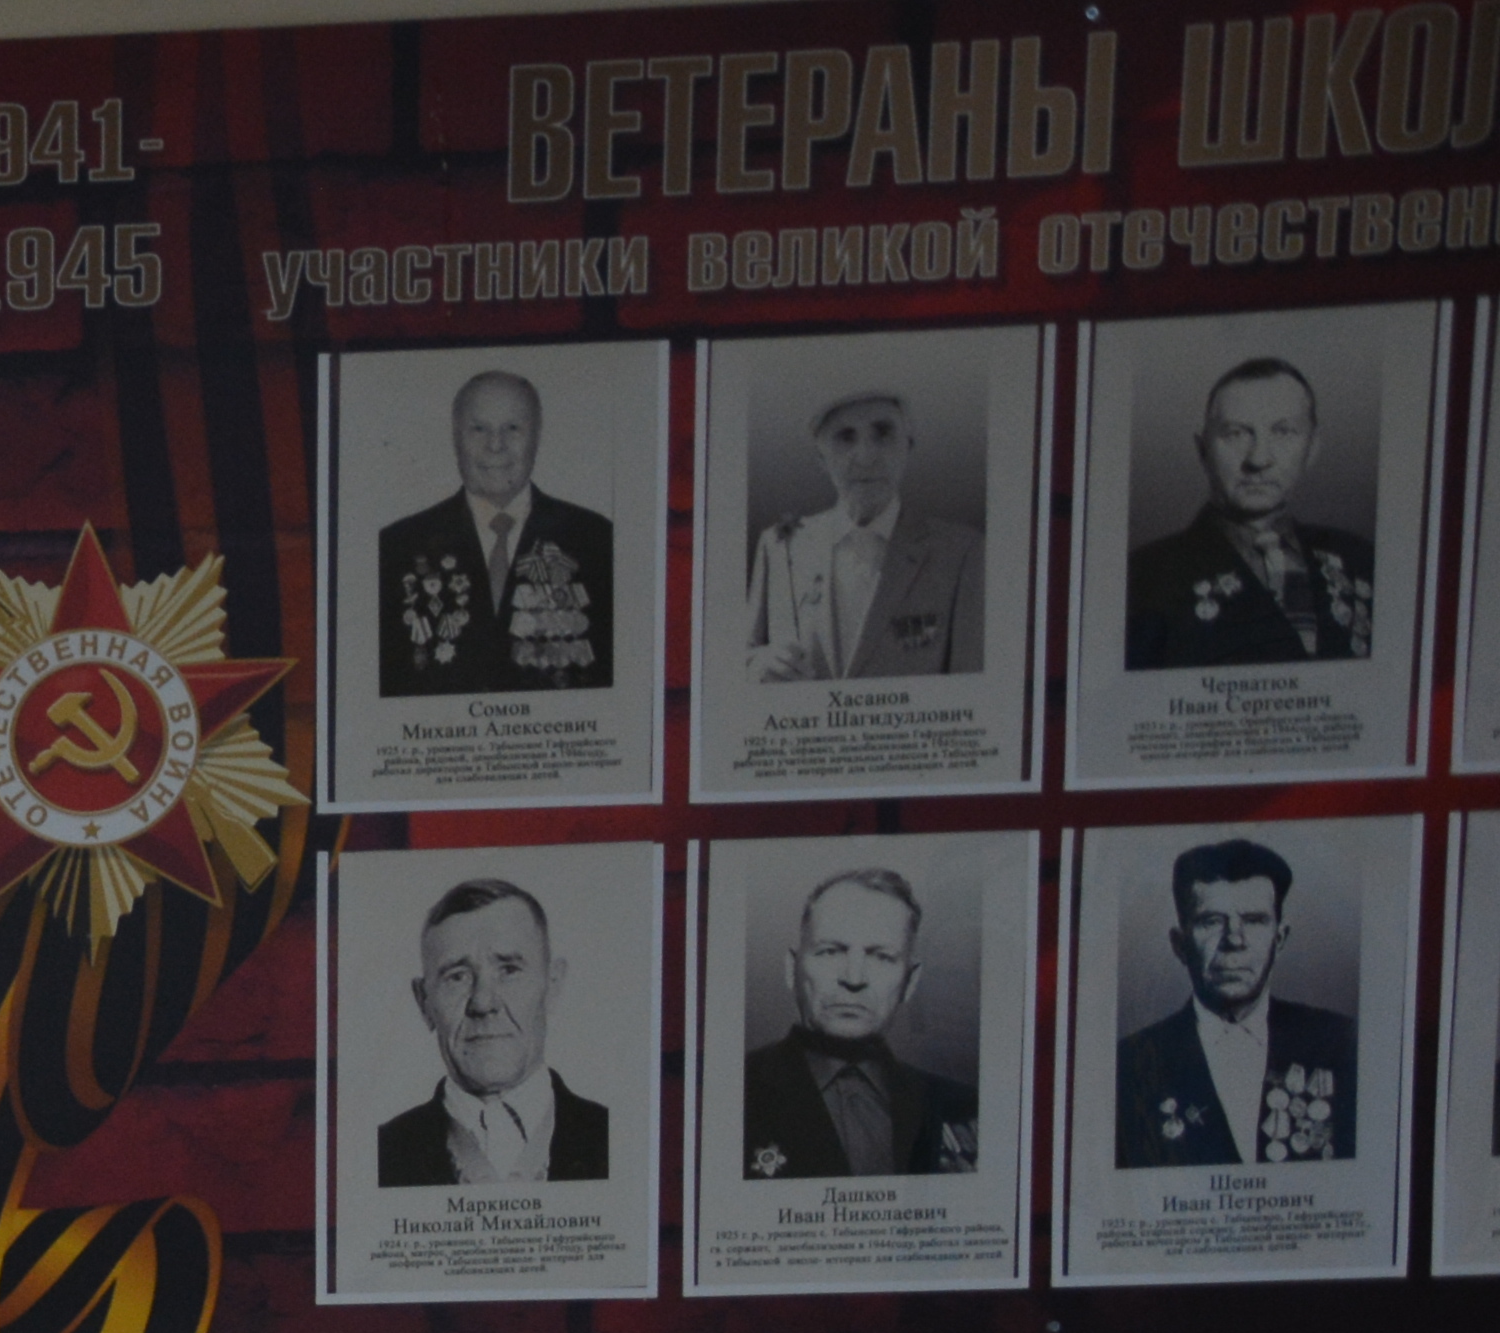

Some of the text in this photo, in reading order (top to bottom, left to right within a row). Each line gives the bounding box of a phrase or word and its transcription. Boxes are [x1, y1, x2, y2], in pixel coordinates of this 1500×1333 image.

[506, 30, 1118, 202] ВЕТЕРАНЫ
[262, 184, 1500, 322] участники великой отечествен
[1202, 676, 1299, 697] Черватюк
[468, 701, 531, 718] Сомов
[828, 690, 910, 708] Хасанов
[1169, 693, 1332, 716] Иван Сергеевич
[401, 718, 598, 741] Михаил Алексеевич
[764, 709, 974, 731] Асхат Шагидуллович
[129, 701, 194, 825] ВОЙНА
[1210, 1174, 1267, 1192] Шеин
[447, 1196, 542, 1216] Маркисов
[821, 1187, 897, 1205] Дашков
[1162, 1192, 1314, 1214] Иван Петрович
[394, 1214, 602, 1234] Николай Михайлович
[778, 1206, 947, 1225] Иван Николаевич
